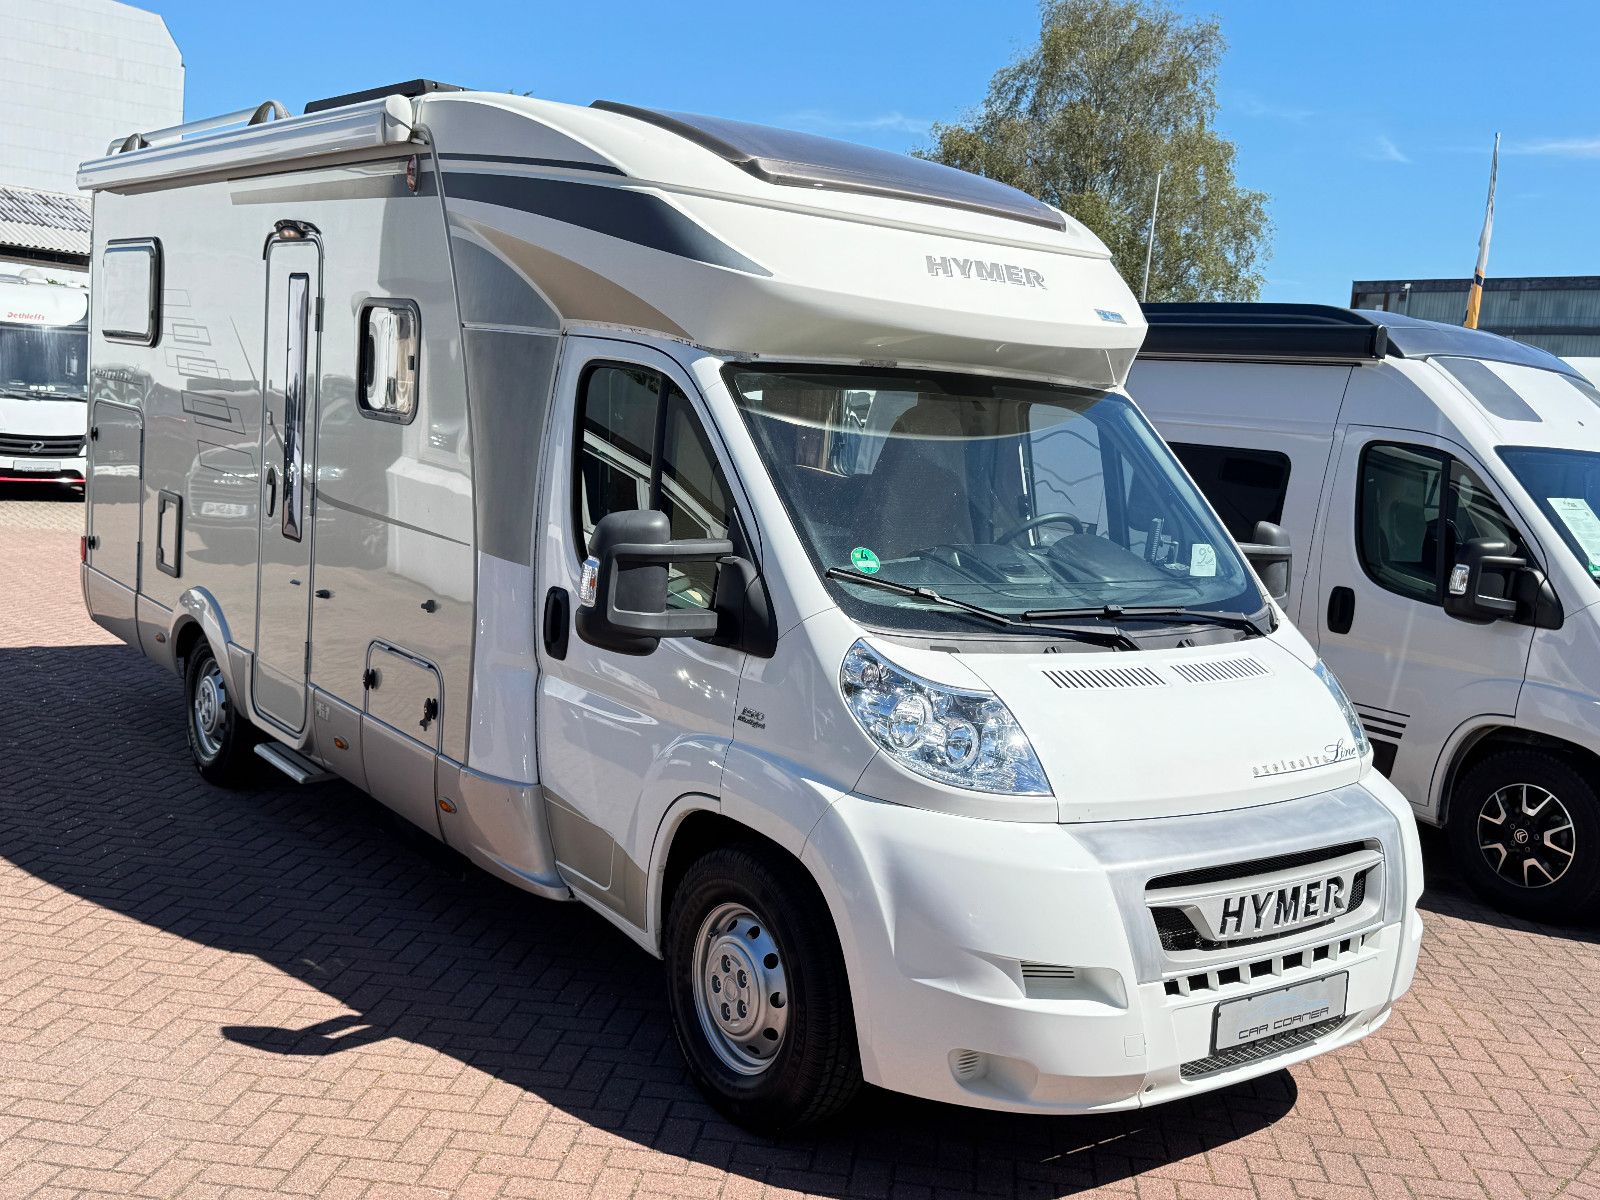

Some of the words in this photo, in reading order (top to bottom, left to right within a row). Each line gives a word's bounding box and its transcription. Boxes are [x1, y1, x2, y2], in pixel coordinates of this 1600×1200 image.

[925, 255, 1047, 290] HYMER
[860, 549, 869, 561] 4
[1324, 738, 1356, 762] Line
[1219, 876, 1346, 937] HYMER
[1238, 1023, 1268, 1040] CAR
[1273, 1006, 1329, 1030] CORNER
